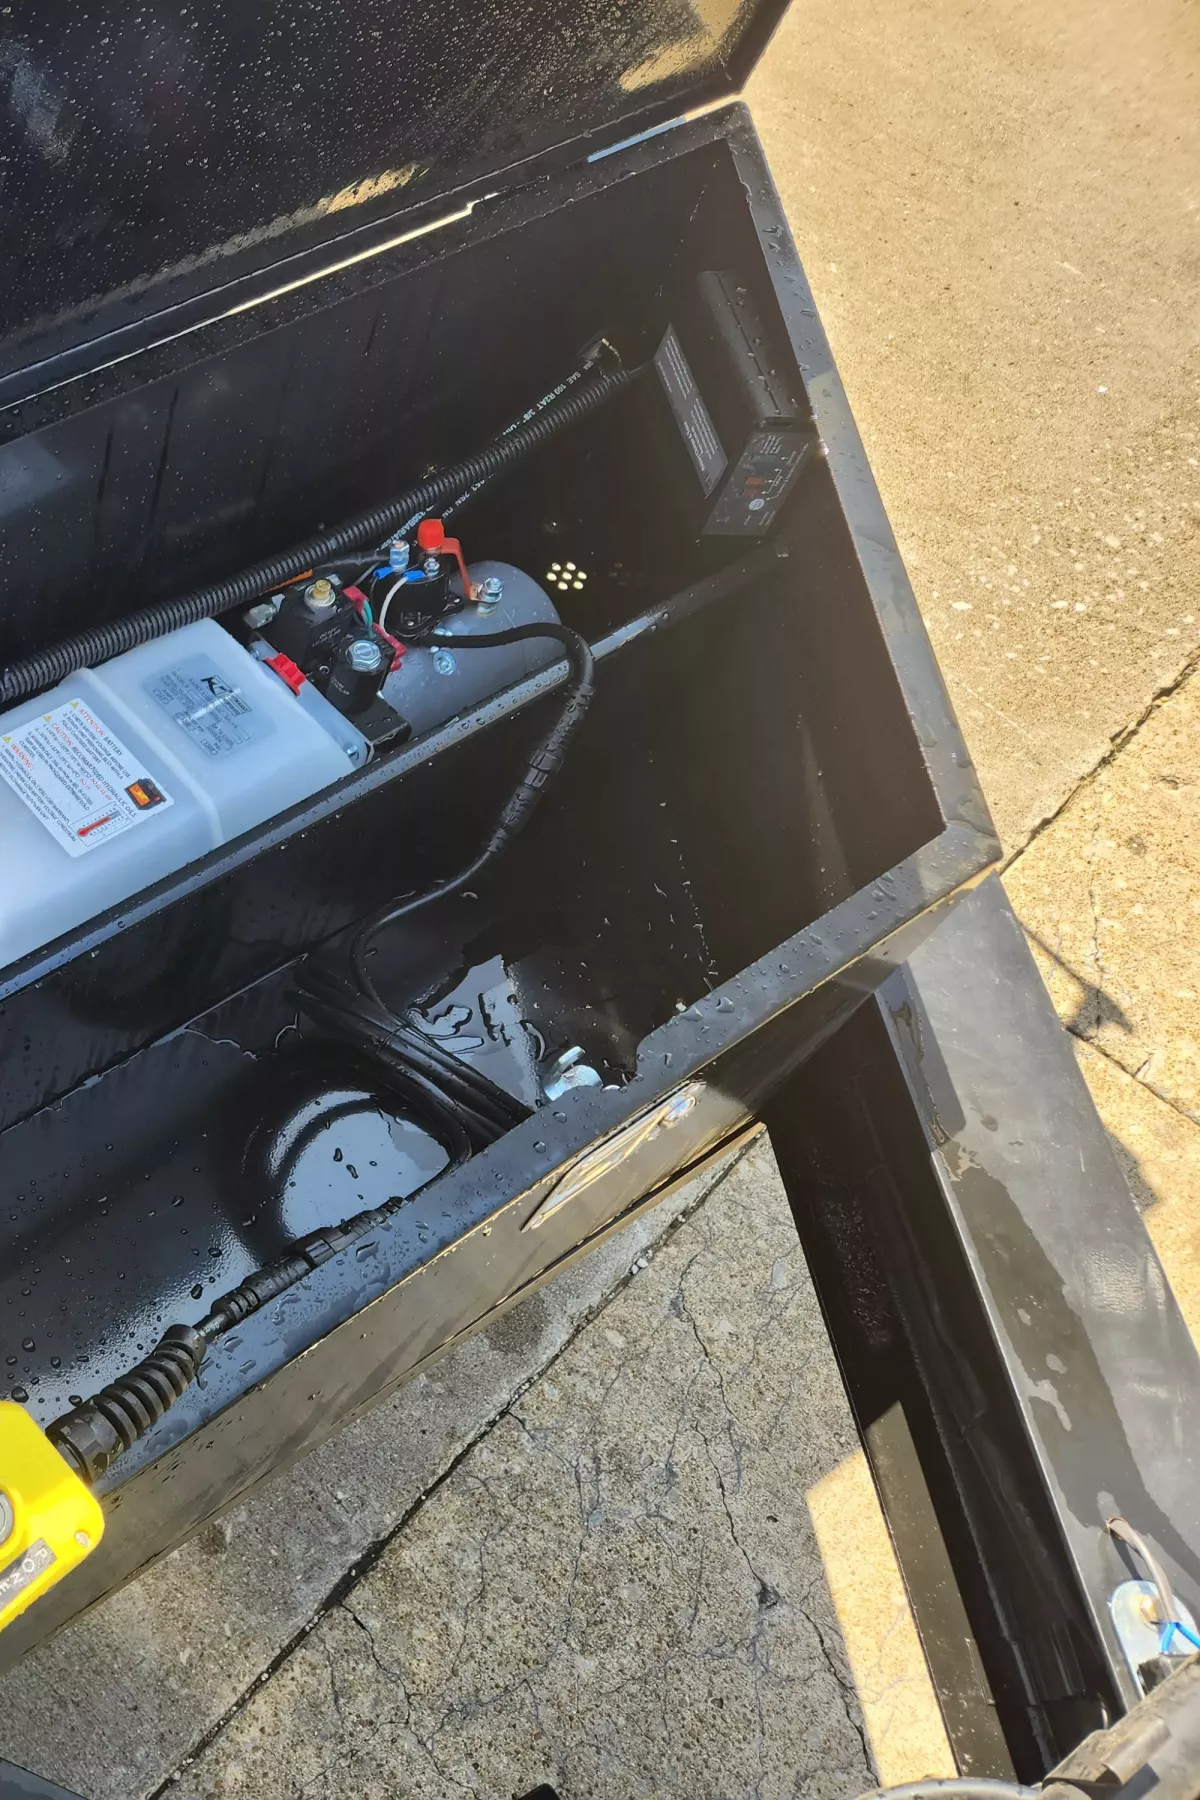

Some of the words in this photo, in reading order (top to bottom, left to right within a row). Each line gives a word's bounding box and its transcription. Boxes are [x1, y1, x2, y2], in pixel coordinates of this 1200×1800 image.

[79, 709, 103, 735] ATTENTION:
[104, 736, 122, 755] BATTERY
[52, 723, 72, 746] CAUTION:
[72, 747, 104, 781] RECOMMENDED
[102, 781, 127, 806] HYDRAULIC
[125, 806, 136, 817] OILS
[85, 748, 100, 763] BATTERY
